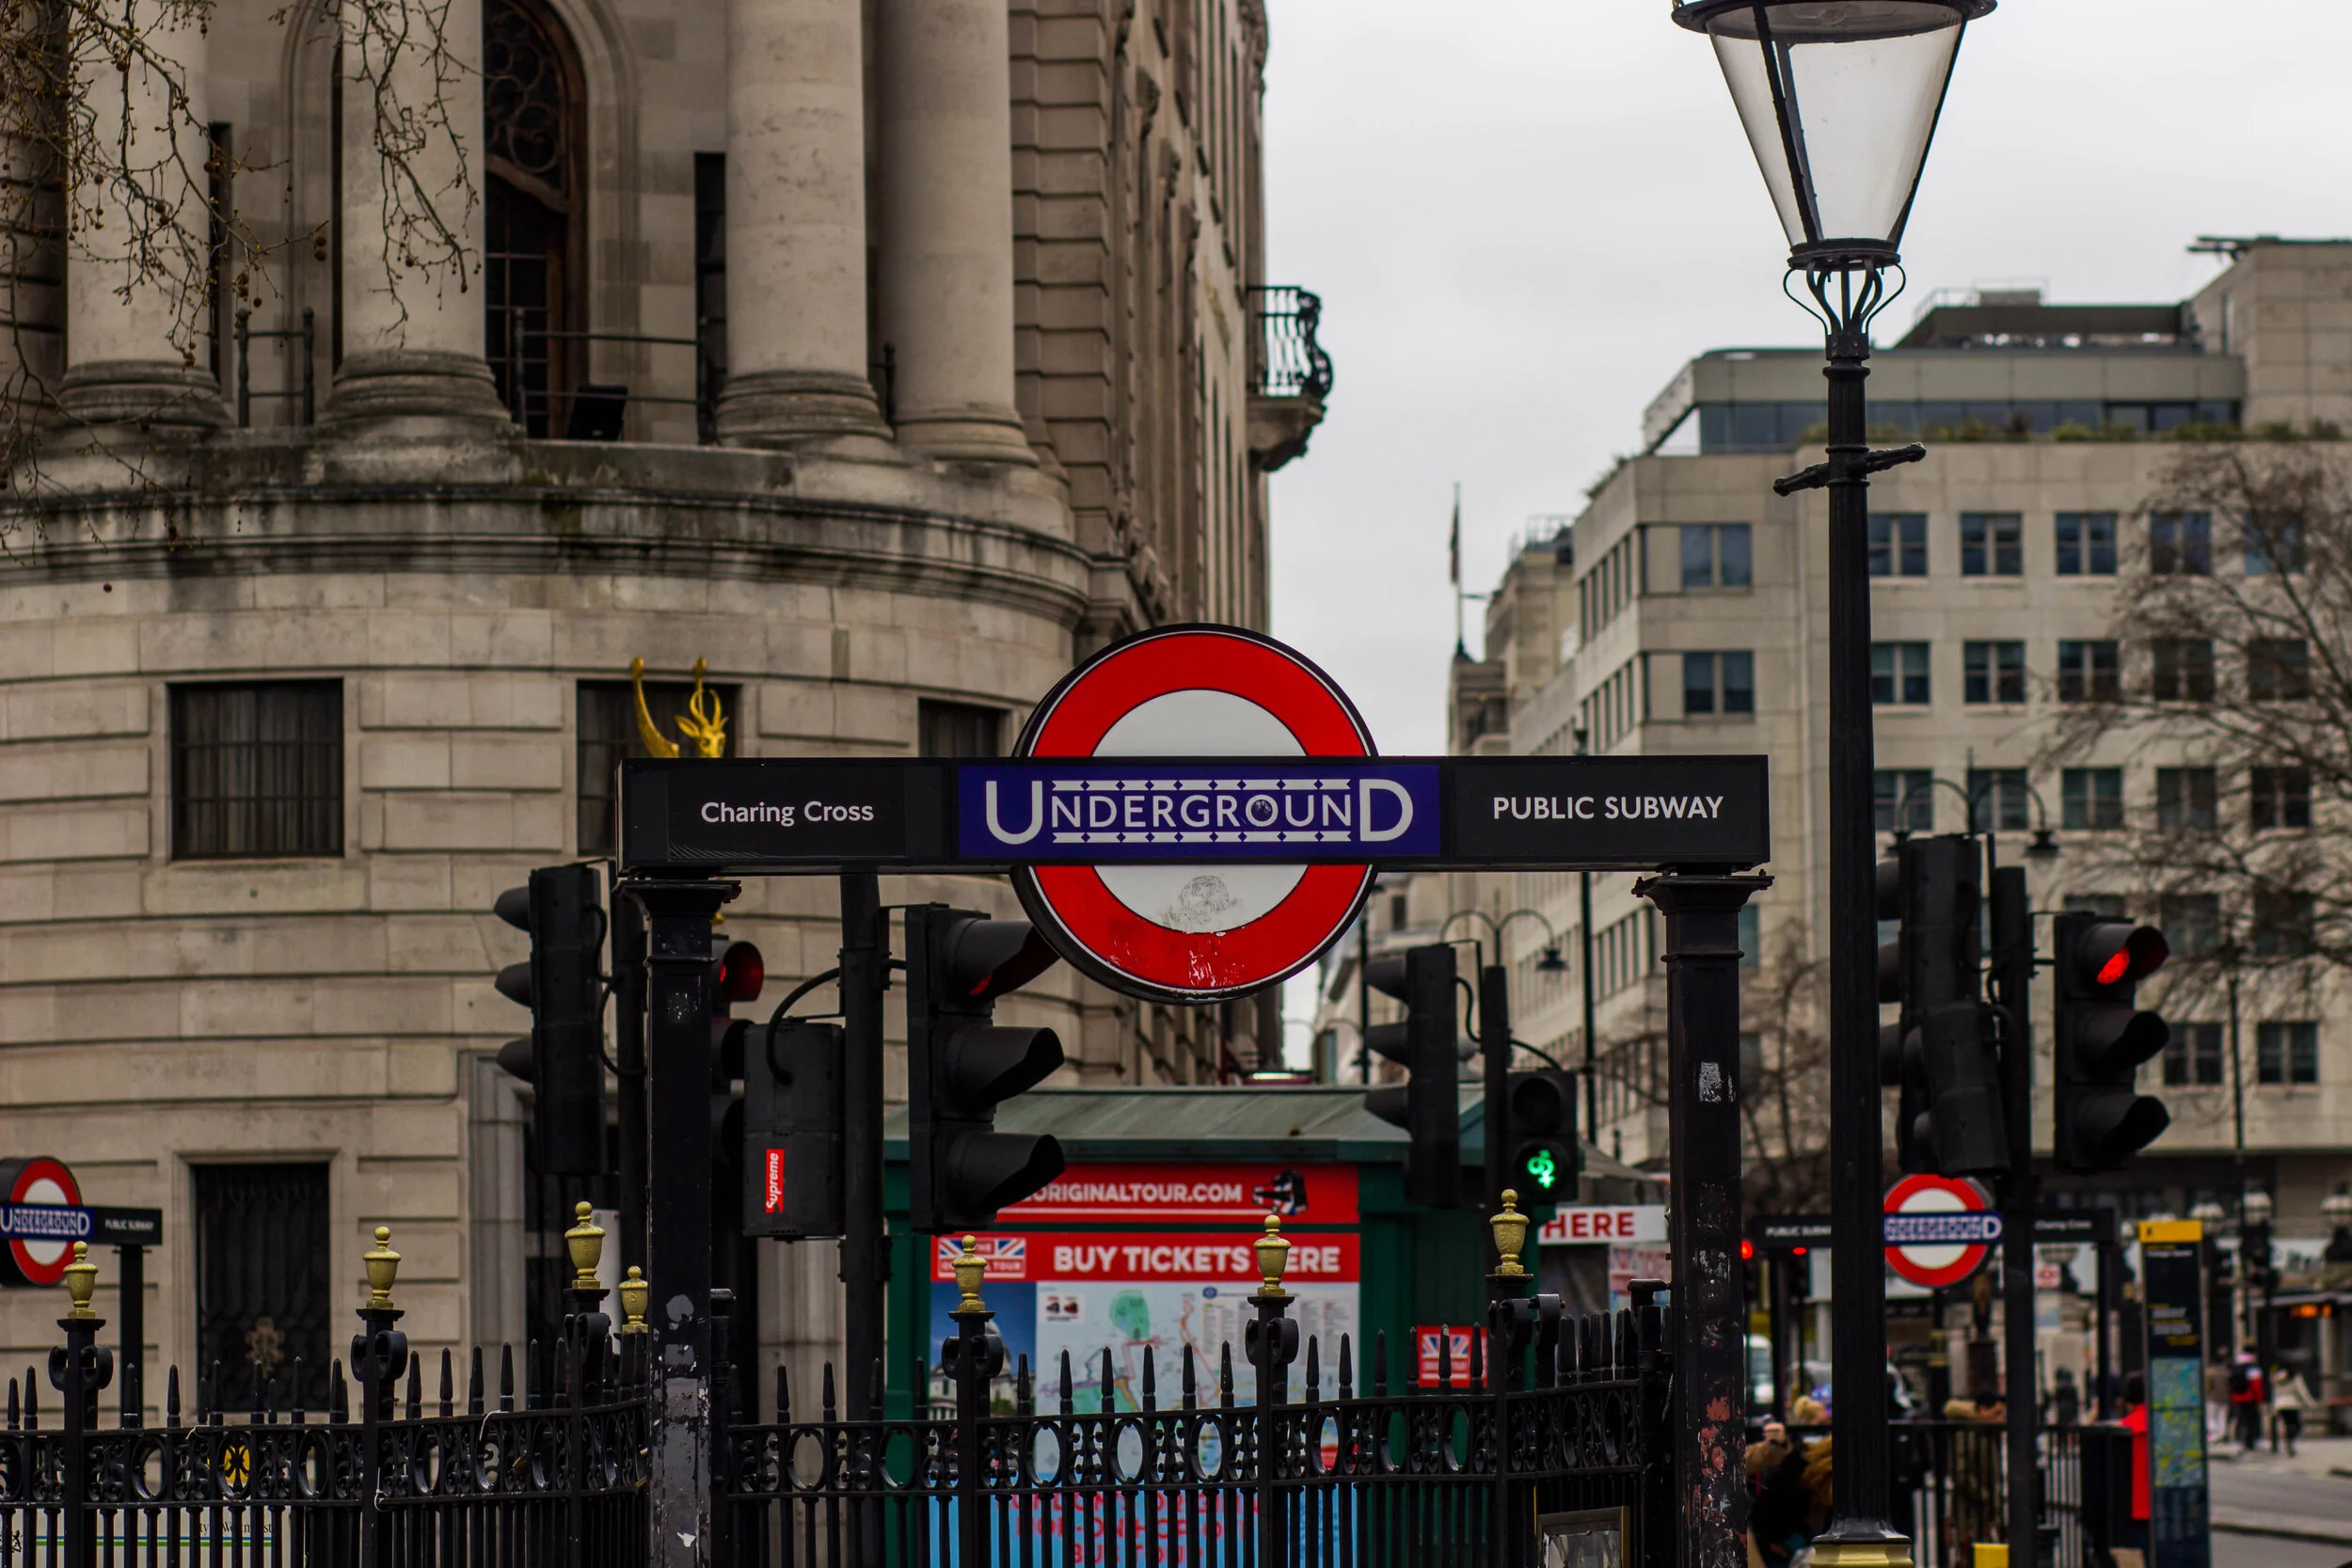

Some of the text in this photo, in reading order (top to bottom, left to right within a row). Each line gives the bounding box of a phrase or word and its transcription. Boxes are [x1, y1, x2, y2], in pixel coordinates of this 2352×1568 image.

[701, 800, 874, 827] Charing Cross
[986, 779, 1413, 845] UNDERGROUND
[1493, 796, 1724, 819] PUBLIC SUBWAY
[1023, 1182, 1242, 1203] ORIGINALTOUR.COM
[0, 1207, 90, 1236] UNDERGROUND
[1545, 1212, 1634, 1239] HERE
[1884, 1215, 2003, 1241] NDERGROUND
[1054, 1245, 1341, 1273] BUY TICKETS ERE
